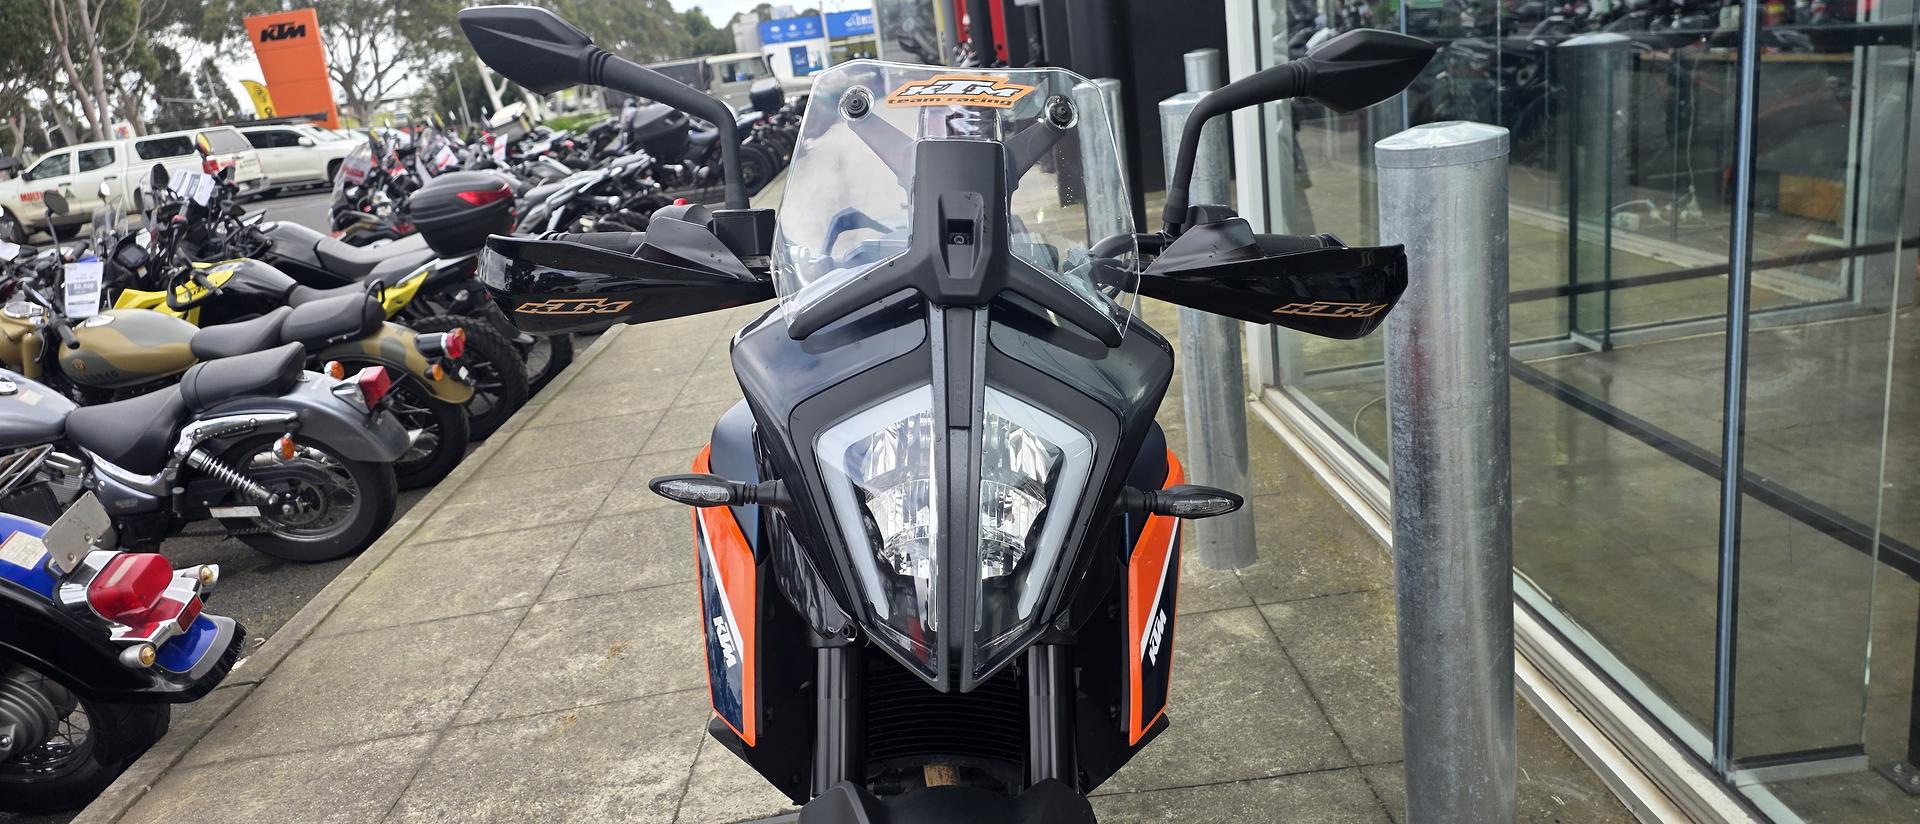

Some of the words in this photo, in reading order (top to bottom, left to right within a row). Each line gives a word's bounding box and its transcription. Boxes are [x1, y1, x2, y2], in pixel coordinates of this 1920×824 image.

[261, 23, 306, 43] KTM
[897, 79, 1024, 99] KTM
[888, 97, 941, 105] team
[950, 97, 1012, 106] racing
[514, 298, 633, 315] KTM
[1271, 301, 1388, 318] KTM
[712, 615, 737, 668] KTM
[1148, 608, 1167, 667] KTM
